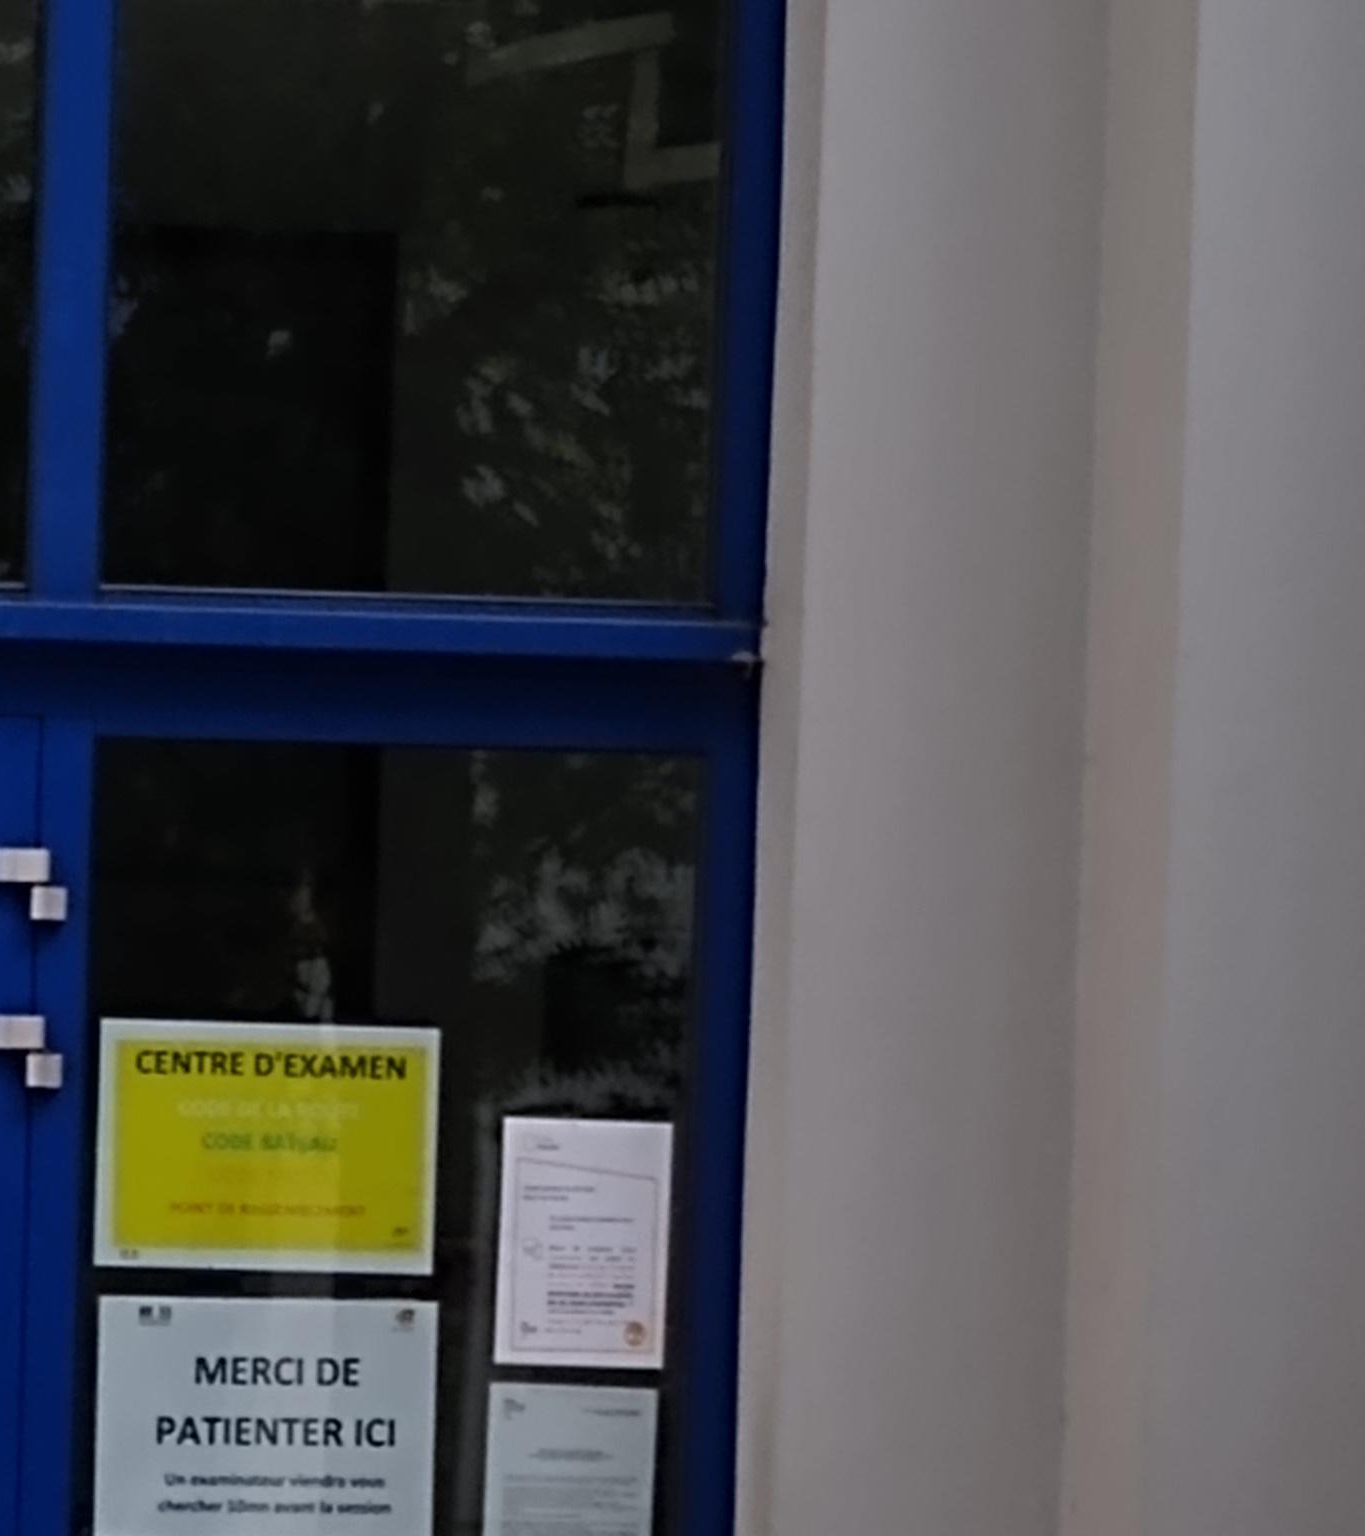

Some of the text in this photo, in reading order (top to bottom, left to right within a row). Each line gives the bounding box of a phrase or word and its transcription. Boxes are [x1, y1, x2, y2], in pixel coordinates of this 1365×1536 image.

[135, 1050, 407, 1080] CENTRE D'EXAMEN
[194, 1357, 361, 1387] MERCI DE
[155, 1416, 396, 1448] PATIENTER ICI
